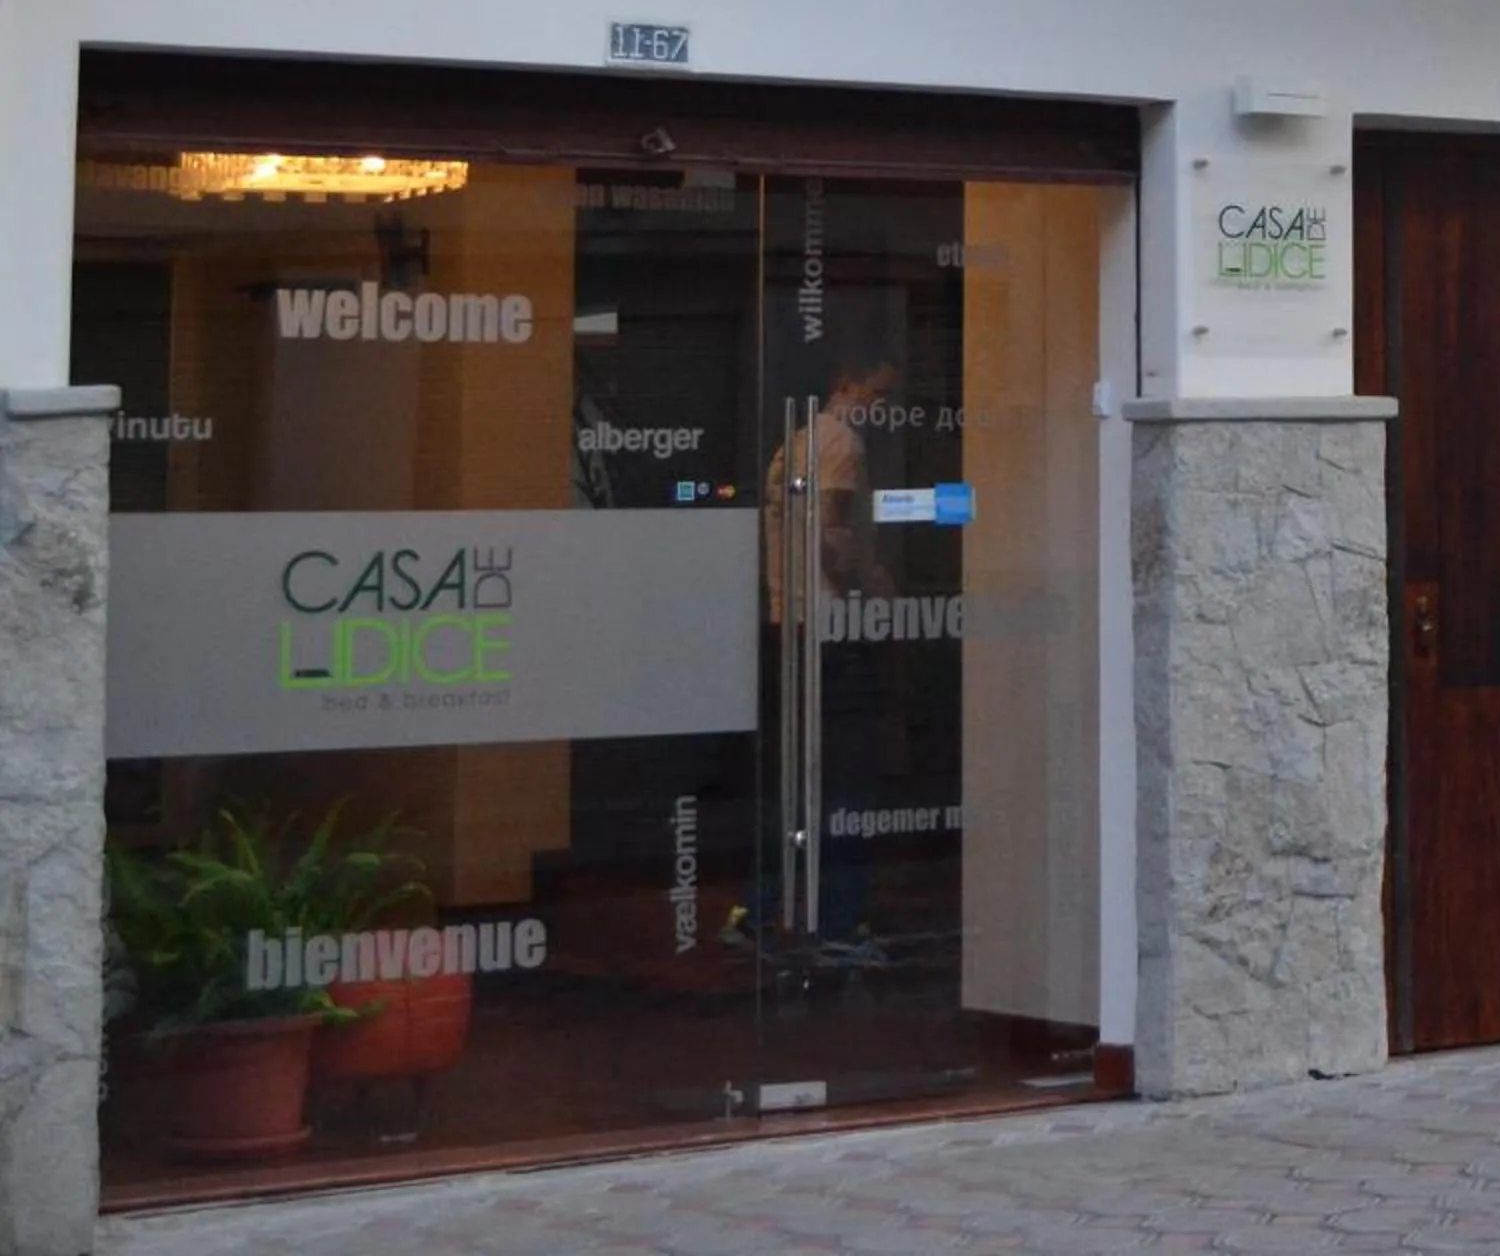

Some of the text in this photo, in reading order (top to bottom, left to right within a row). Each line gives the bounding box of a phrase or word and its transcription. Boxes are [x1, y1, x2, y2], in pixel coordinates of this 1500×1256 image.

[614, 27, 688, 60] 11-67
[1218, 205, 1326, 241] CASA DE
[1218, 242, 1326, 279] LIDICE
[276, 281, 533, 342] welcome
[110, 410, 213, 441] inutu
[577, 422, 705, 459] alberger
[282, 547, 513, 613] CASA DE
[279, 611, 515, 689] LIDICE
[830, 806, 939, 839] degemer
[245, 918, 547, 992] bienvenue
